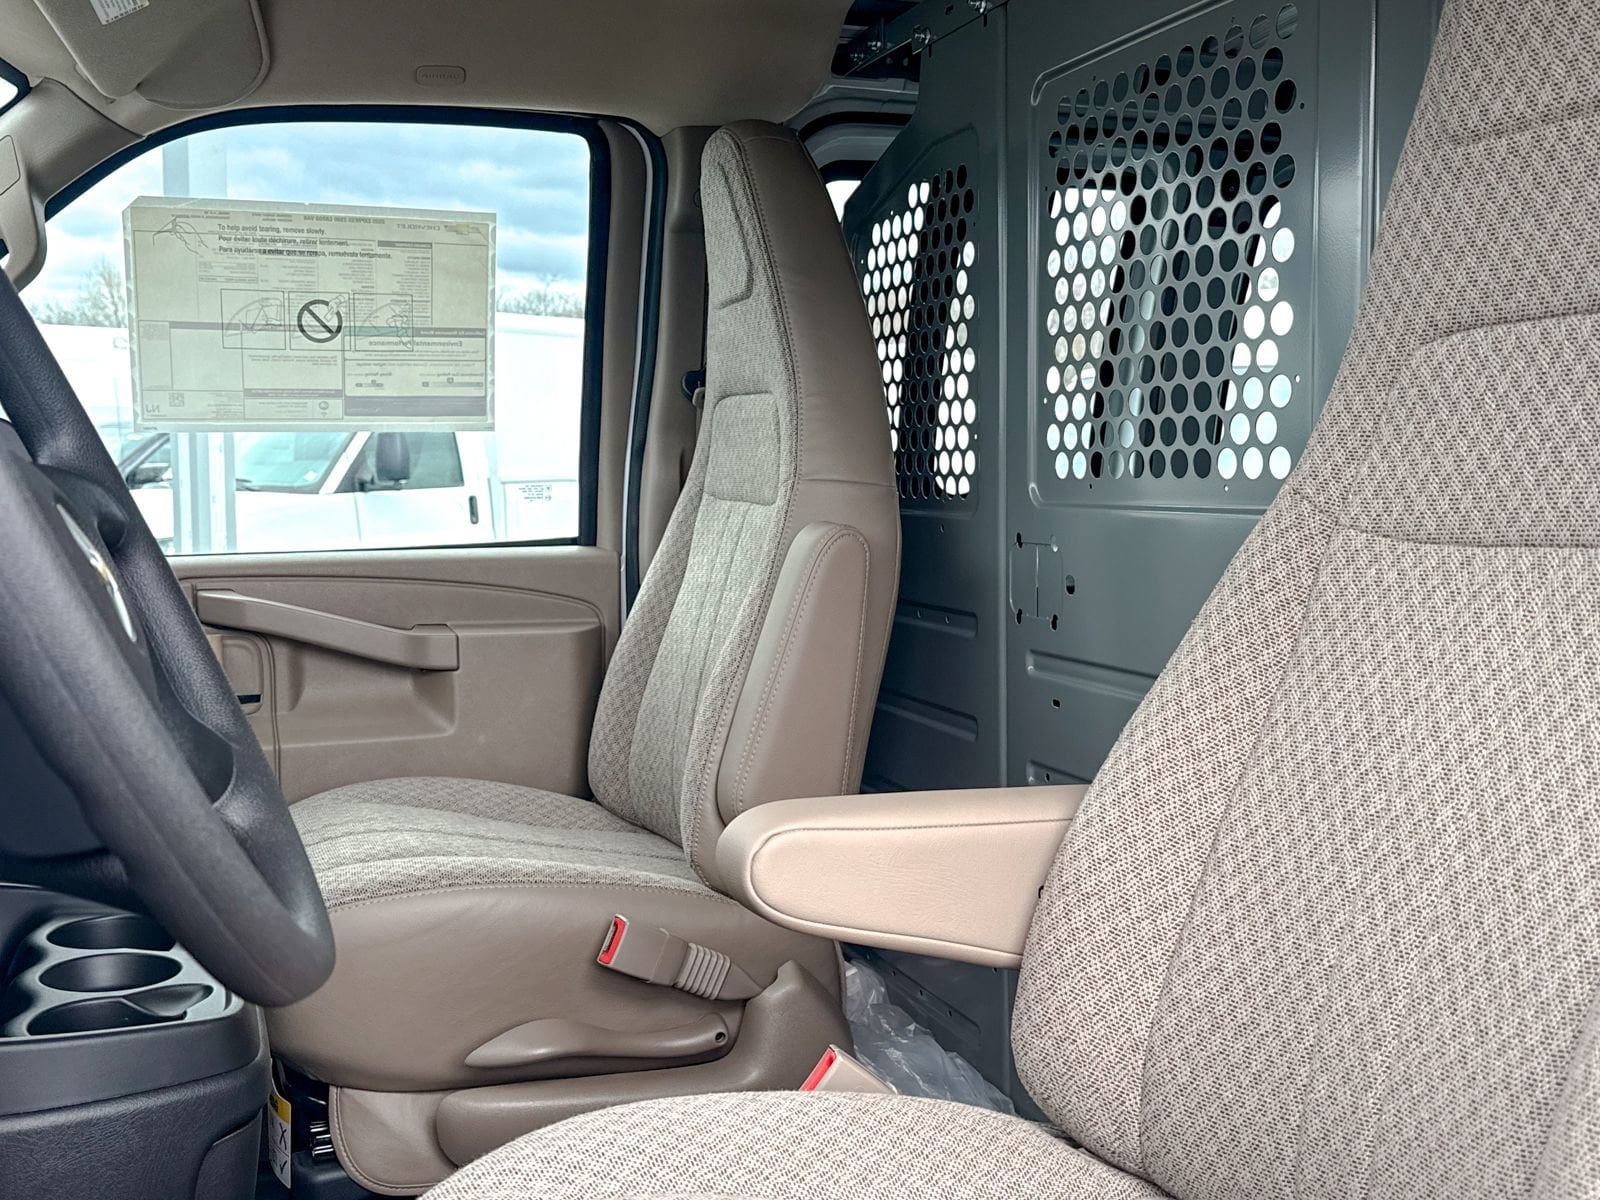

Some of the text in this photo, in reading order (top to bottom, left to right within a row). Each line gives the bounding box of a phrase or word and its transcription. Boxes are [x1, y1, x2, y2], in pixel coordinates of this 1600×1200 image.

[217, 223, 226, 231] To
[226, 224, 240, 233] help
[258, 225, 281, 234] tearing,
